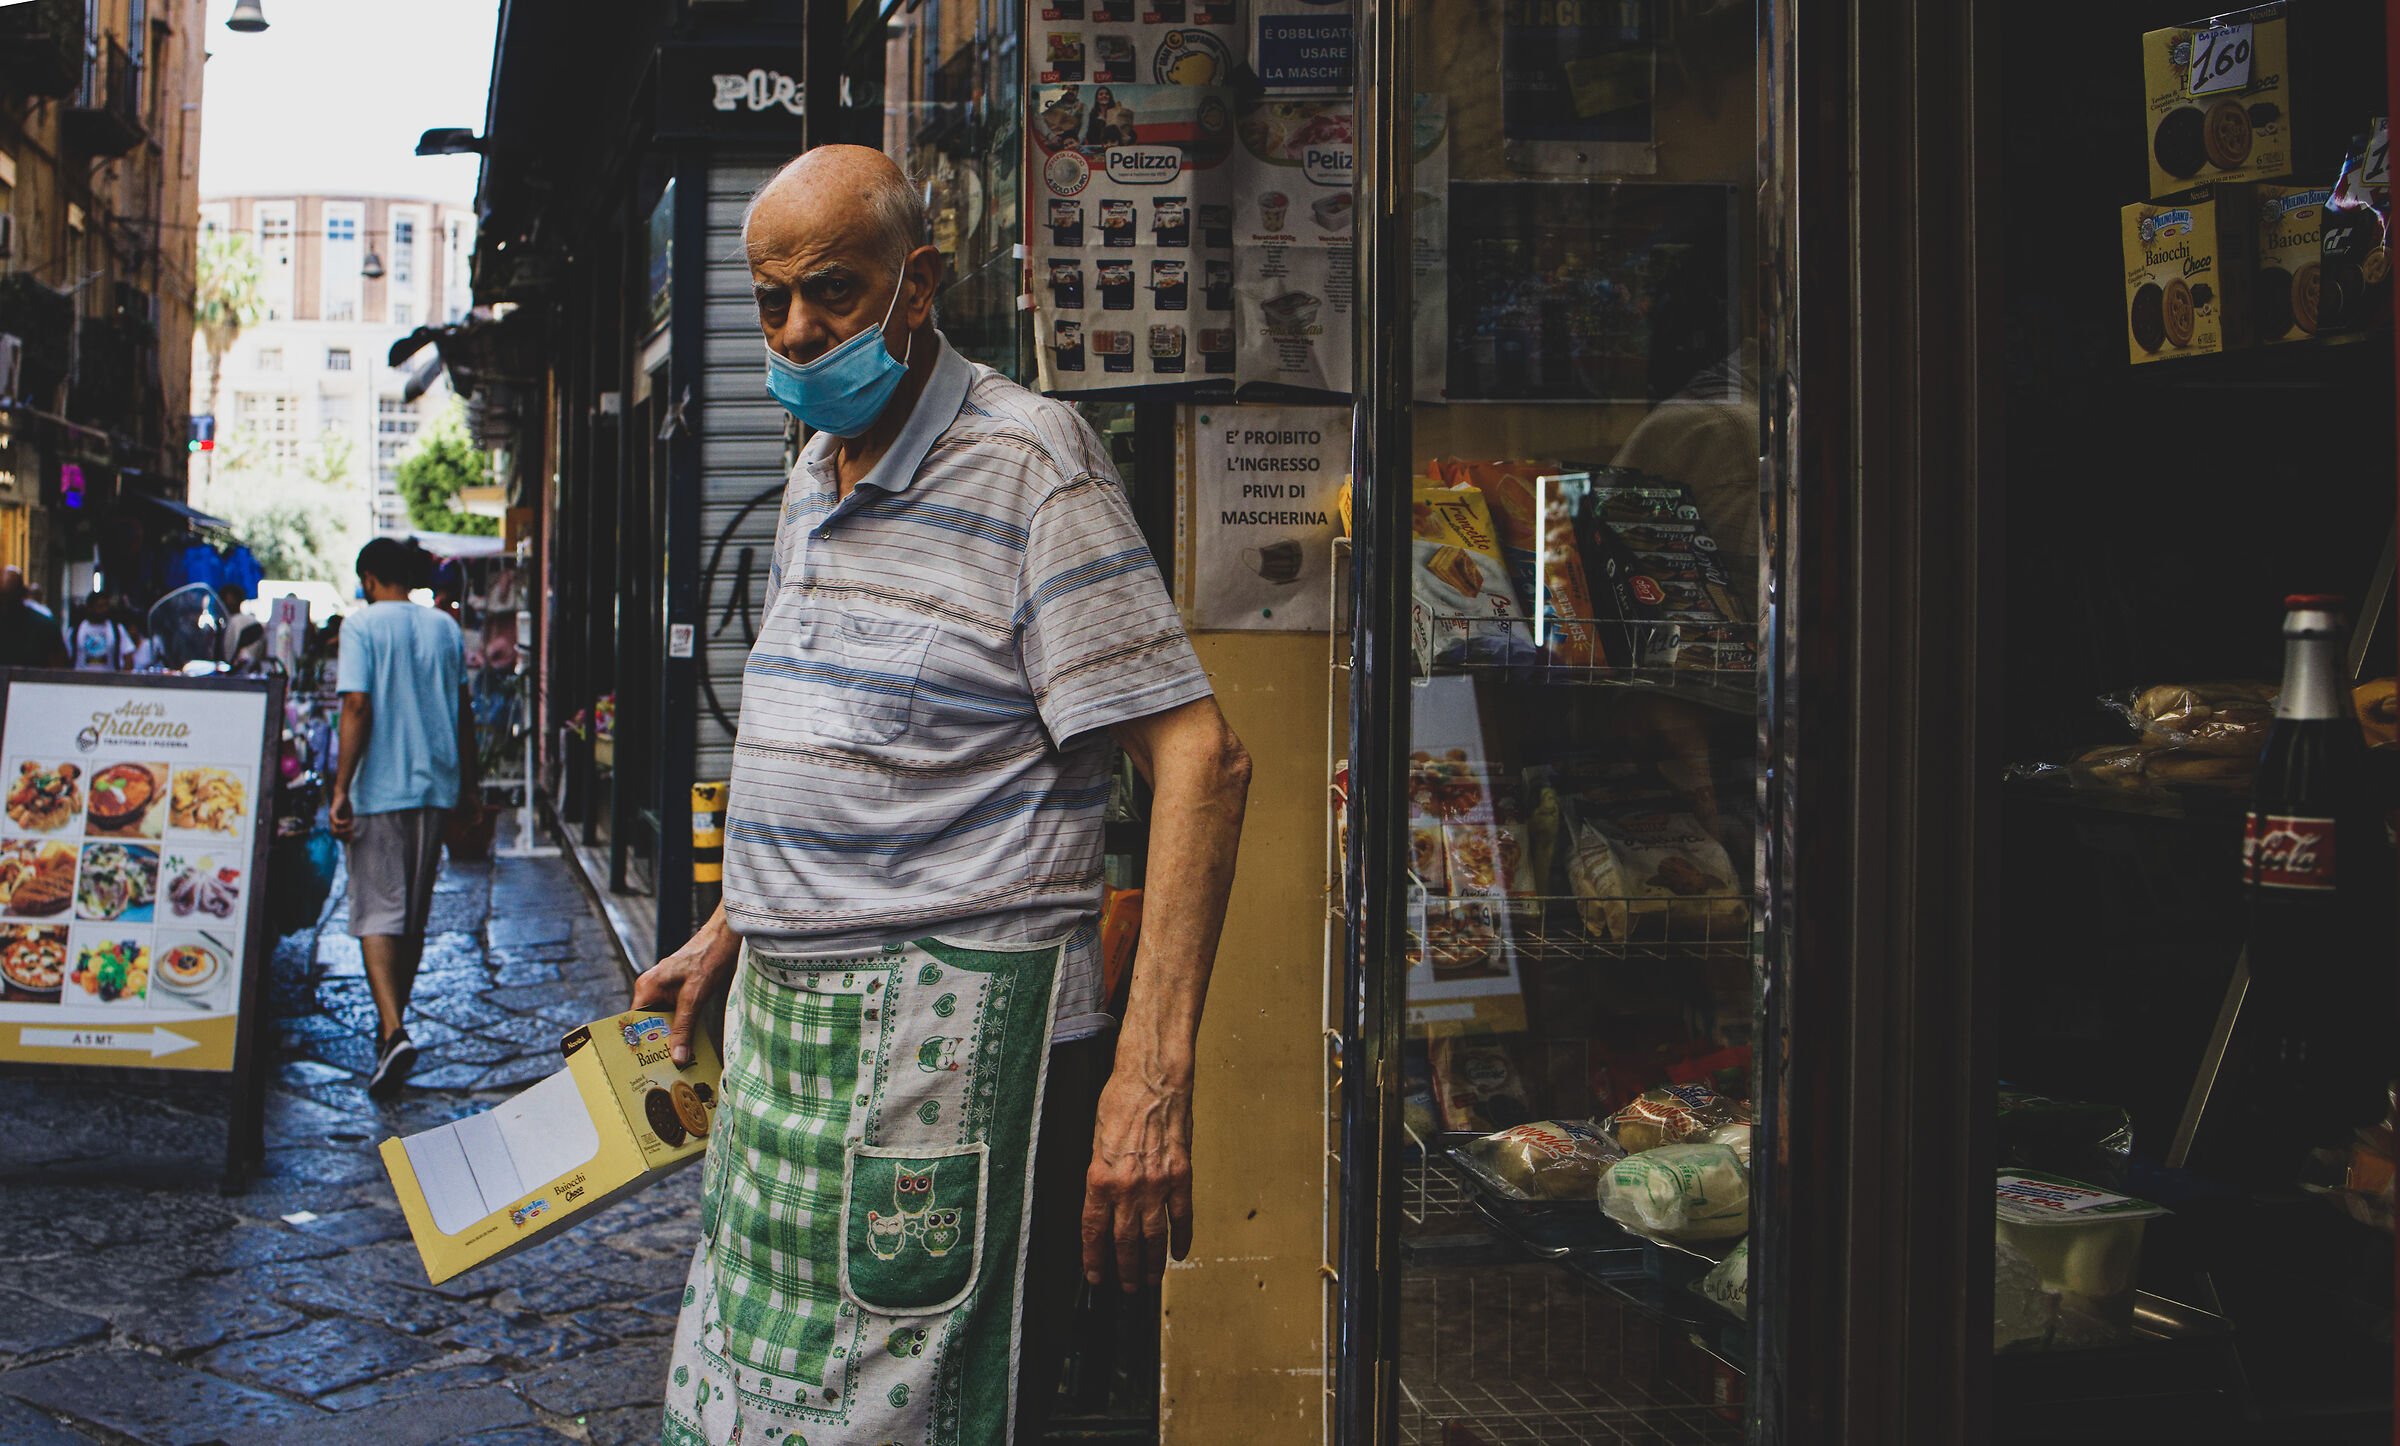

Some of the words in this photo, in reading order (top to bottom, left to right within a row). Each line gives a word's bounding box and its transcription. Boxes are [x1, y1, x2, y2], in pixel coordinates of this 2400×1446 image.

[1300, 47, 1348, 59] USARE
[1265, 67, 1284, 79] LA
[1110, 152, 1177, 169] Pelizza
[2269, 229, 2320, 250] Baiocc
[2145, 241, 2190, 267] Baiocchi
[2183, 255, 2212, 276] Choco
[1244, 431, 1321, 445] PROIBITO
[1243, 485, 1284, 498] PRIVI
[1289, 485, 1306, 498] DI
[1221, 511, 1329, 525] MASCHERINA
[553, 1172, 586, 1196] Baiocchi
